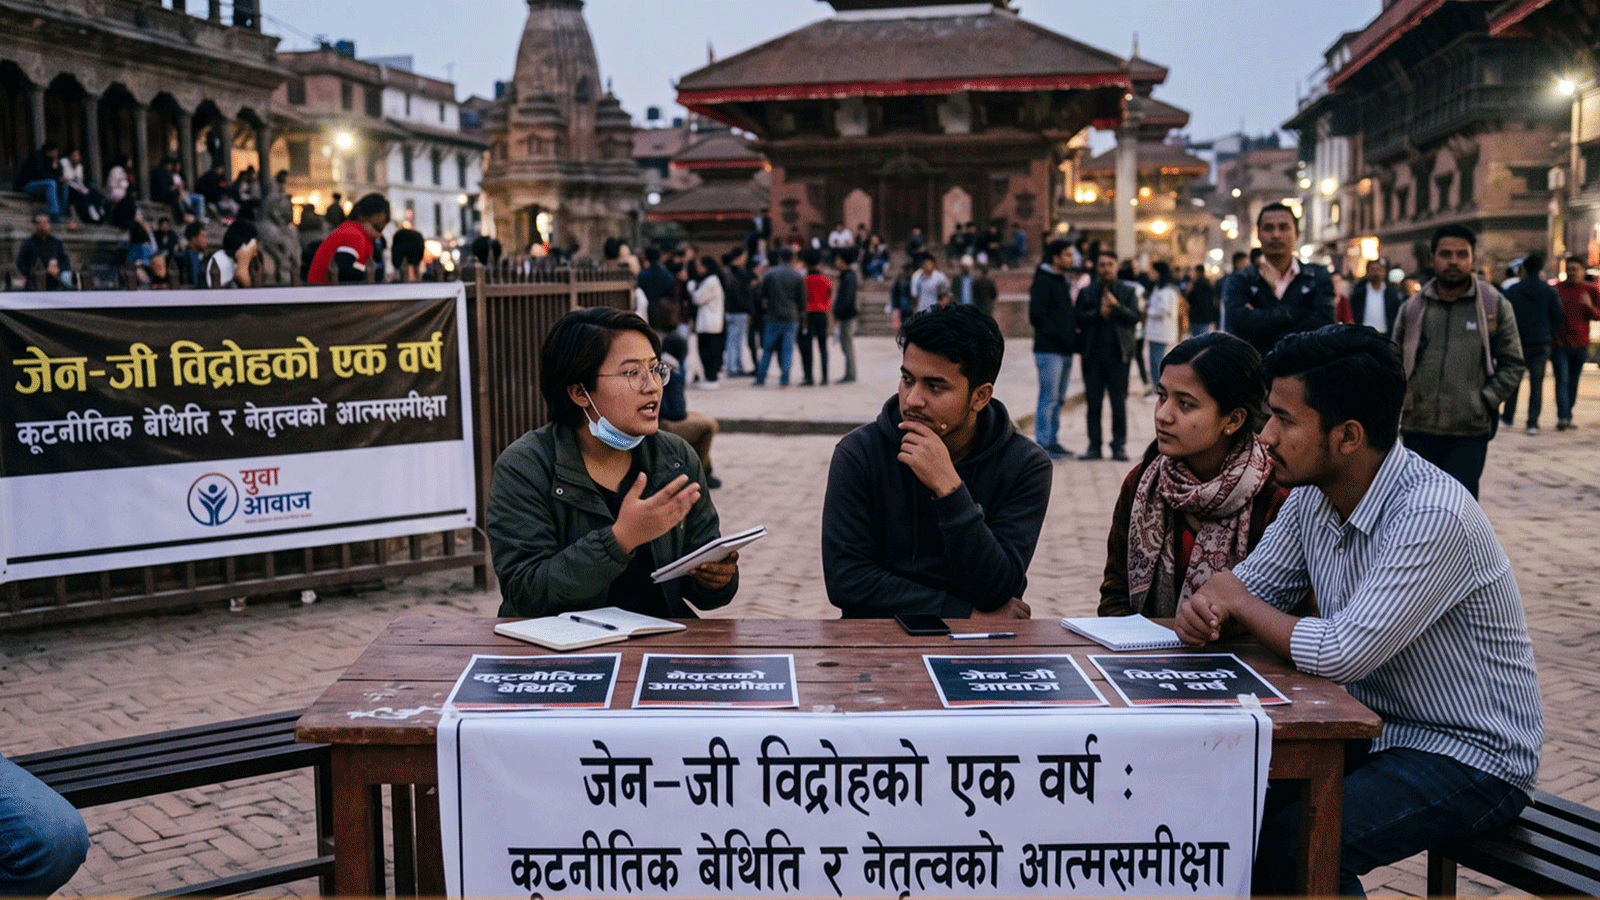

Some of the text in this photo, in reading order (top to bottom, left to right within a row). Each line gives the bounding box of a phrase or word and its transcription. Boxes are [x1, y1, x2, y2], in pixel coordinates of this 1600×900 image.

[12, 331, 444, 394] जेन-जी विद्रोहको एक वर्ष
[15, 390, 448, 454] कूटनीतिक बेथिति र नेतृत्वको आत्मसमीक्षा
[239, 467, 280, 495] युवा
[243, 491, 312, 515] आवाज
[473, 670, 605, 683] कूटनीतिक
[959, 668, 1058, 680] जेन-जी
[968, 681, 1061, 692] आवाज
[1184, 679, 1228, 691] वर्ष
[579, 736, 741, 808] जेन-जी
[756, 735, 930, 817] विद्रोहको
[946, 755, 1021, 818] एक
[1036, 733, 1102, 805] वर्ष
[696, 828, 806, 893] बेथिति
[819, 846, 849, 898] र
[1019, 824, 1231, 893] आत्मसमीक्षा
